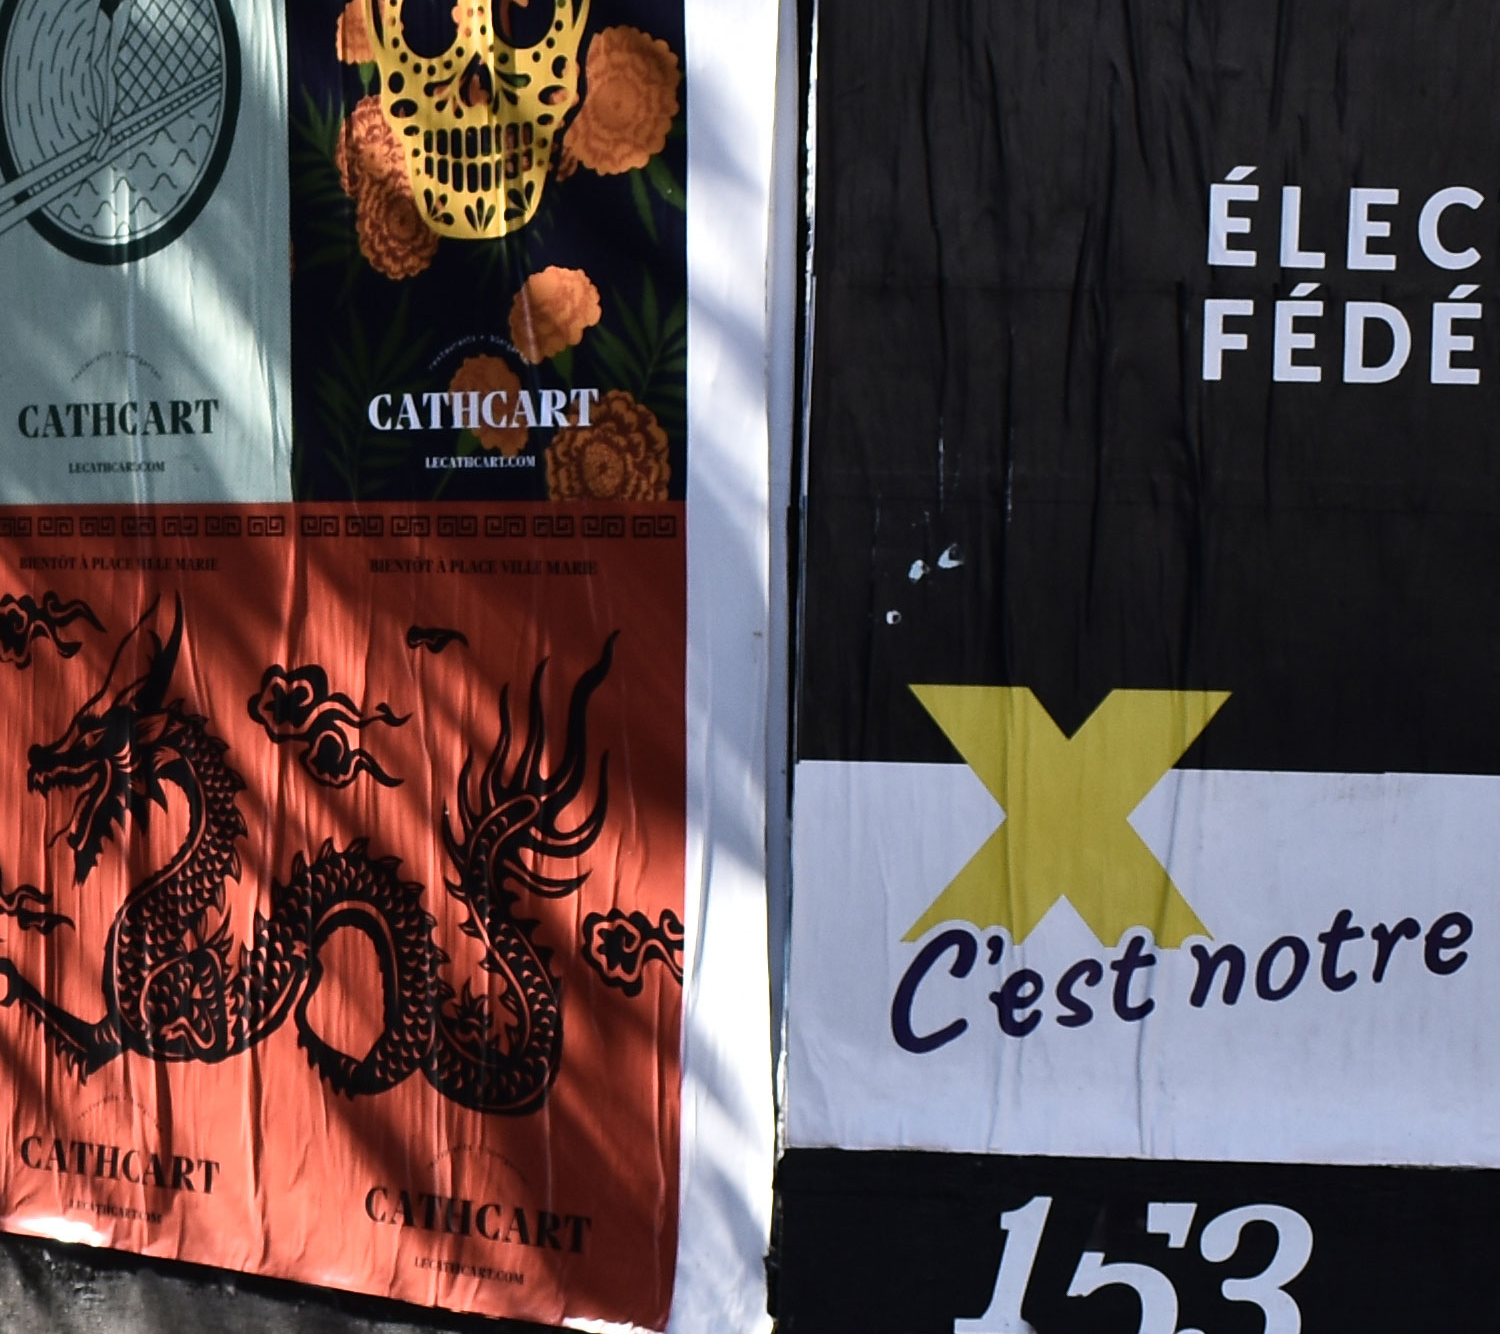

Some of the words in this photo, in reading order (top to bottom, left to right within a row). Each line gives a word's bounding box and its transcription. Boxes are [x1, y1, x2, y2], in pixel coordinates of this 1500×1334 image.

[17, 398, 220, 439] CATHCART
[367, 388, 600, 431] CATHCART
[424, 455, 536, 469] LECATHCART.COM
[92, 557, 134, 572] PLACE
[176, 558, 219, 573] MARIE
[450, 558, 498, 575] PLACE
[499, 558, 543, 576] VILLE
[545, 559, 598, 577] MARIE
[889, 925, 1158, 1055] C'est
[1188, 907, 1475, 1007] notre
[19, 1135, 221, 1195] CATHCART
[364, 1185, 593, 1255] CATHCART
